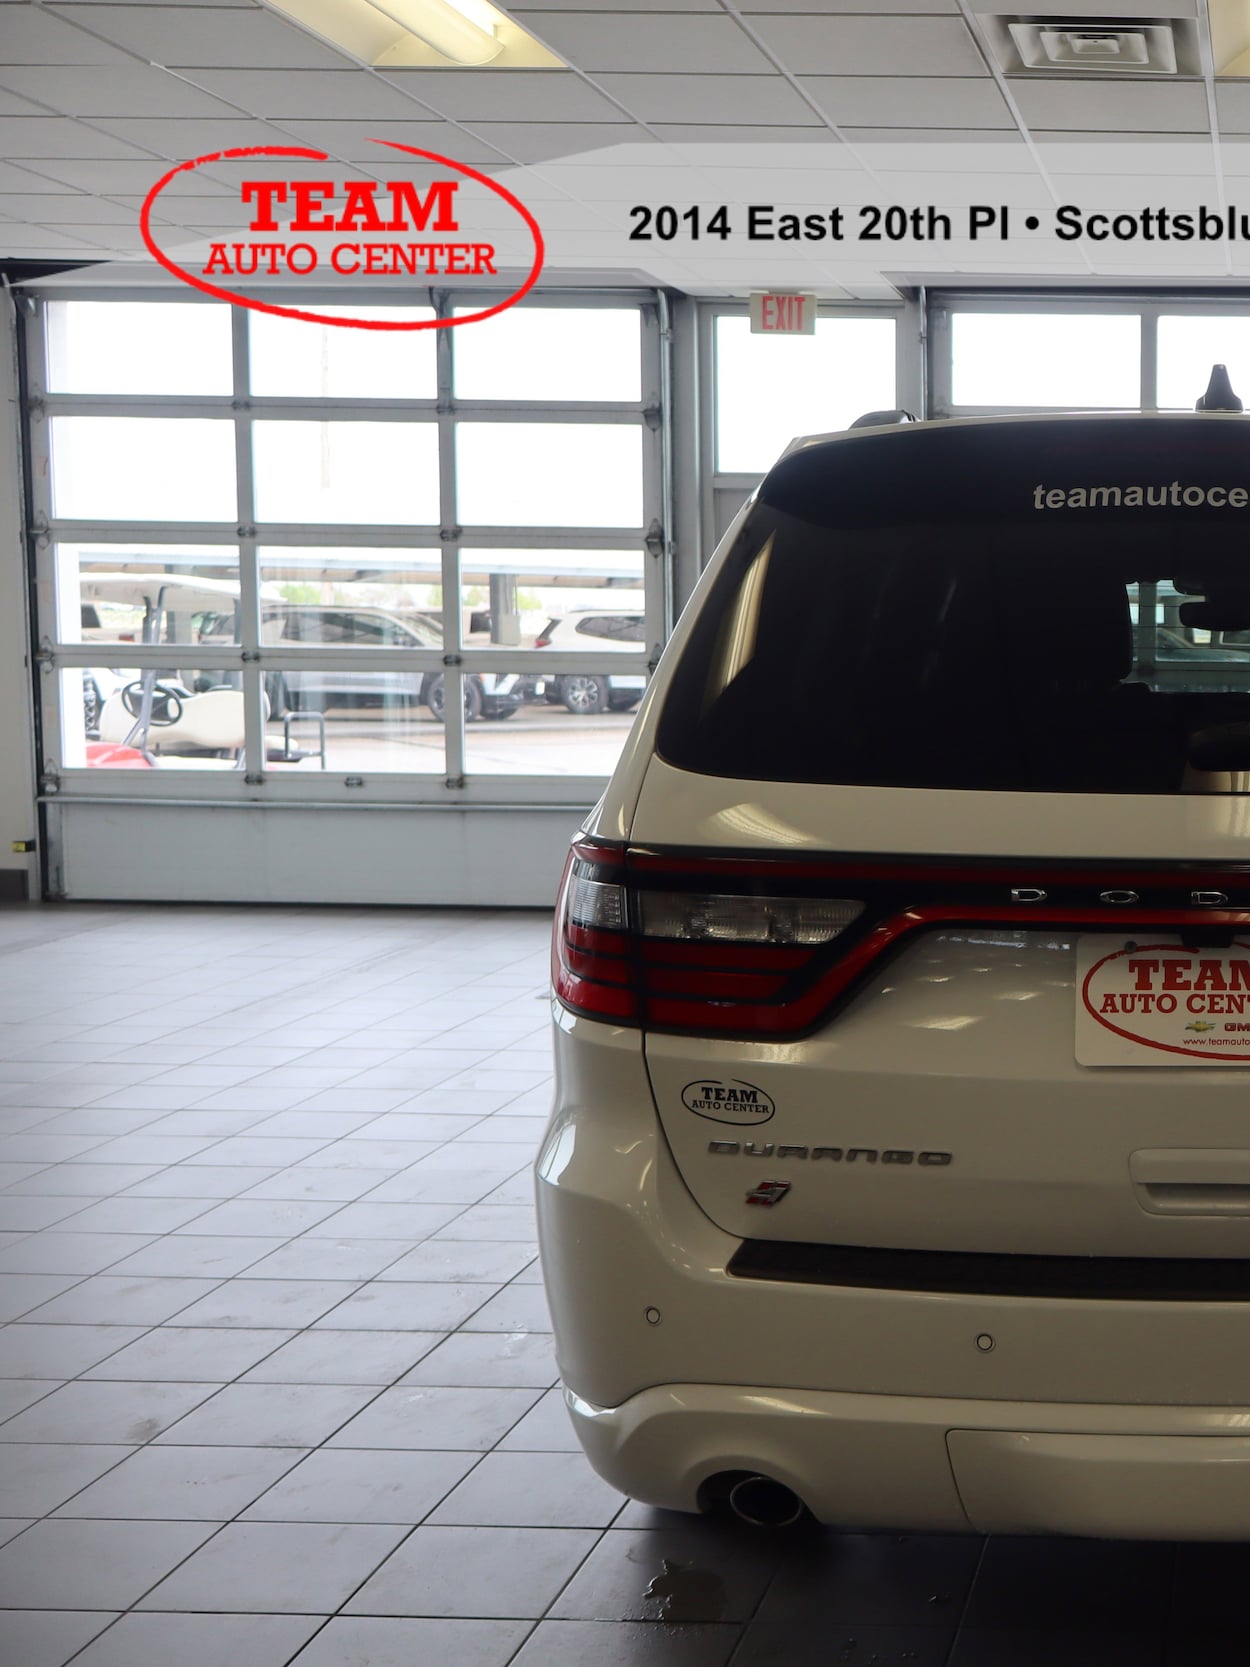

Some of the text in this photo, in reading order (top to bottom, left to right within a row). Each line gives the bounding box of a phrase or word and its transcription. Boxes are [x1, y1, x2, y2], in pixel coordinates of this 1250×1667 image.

[762, 295, 805, 331] EXIT
[1100, 993, 1178, 1014] AUTO
[701, 1086, 758, 1103] TEAM
[692, 1099, 769, 1113] AUTO CENTER
[707, 1140, 953, 1166] DURANGO
